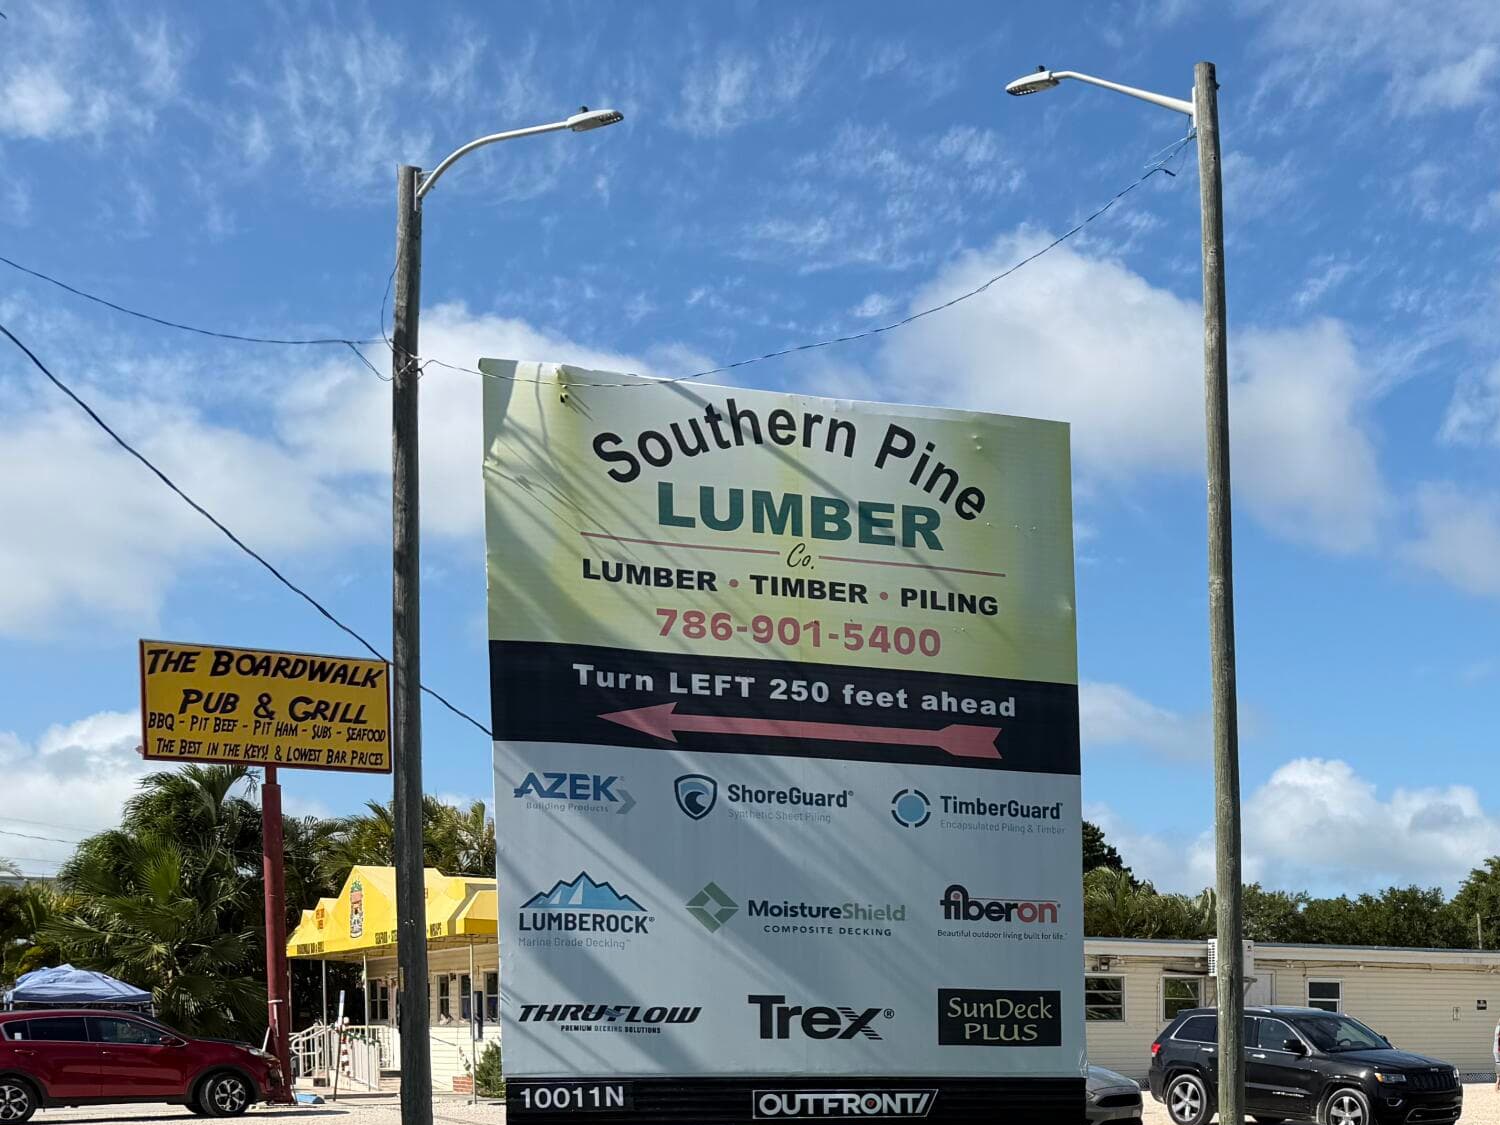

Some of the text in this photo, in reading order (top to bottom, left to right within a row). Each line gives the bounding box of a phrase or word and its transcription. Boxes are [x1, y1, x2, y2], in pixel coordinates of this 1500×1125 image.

[592, 398, 986, 522] Southern Pine
[658, 482, 944, 552] LUMBER
[785, 543, 815, 571] Co.
[583, 559, 999, 617] LUMBER TIMBER PILING
[656, 608, 941, 657] 786-901-5400
[148, 649, 384, 689] THE BOARDWALK
[572, 663, 1016, 718] Turn LEFT 250 feet ahead
[179, 689, 368, 725] PUB & GRILL
[148, 712, 175, 732] BBQ
[190, 716, 210, 732] PIT
[214, 717, 238, 733] BEEF
[253, 720, 271, 736] PIT
[275, 721, 298, 738] HAM
[312, 724, 332, 740] SUBS
[347, 727, 386, 743] SEAFOOD
[157, 738, 176, 754] THE
[179, 740, 203, 755] BEST
[207, 742, 219, 756] IN
[223, 743, 240, 758] THE
[275, 746, 283, 762] &
[287, 746, 323, 762] LOWEST
[327, 749, 347, 764] BAR
[351, 750, 383, 766] PRICES
[514, 772, 619, 802] AZEK
[568, 803, 609, 813] Products
[728, 809, 831, 824] Synthetic Sheet Piling
[940, 796, 1061, 820] TimberGuard
[941, 820, 1065, 835] Encapsulated Piling & Timber
[748, 900, 905, 922] MoistureShield
[940, 885, 1058, 923] fiberon
[518, 937, 550, 947] Marine
[554, 938, 583, 948] Grade
[764, 925, 892, 937] COMPOSITE DECKING
[938, 930, 971, 938] Beautiful
[972, 930, 1002, 939] outdoor
[1003, 931, 1022, 940] living
[1024, 932, 1040, 940] built
[947, 997, 1053, 1019] SunDeck
[561, 1024, 661, 1034] PREMIUM DECKING SOLUTIONS
[964, 1023, 1039, 1041] PLUS
[519, 1085, 625, 1110] 10011N
